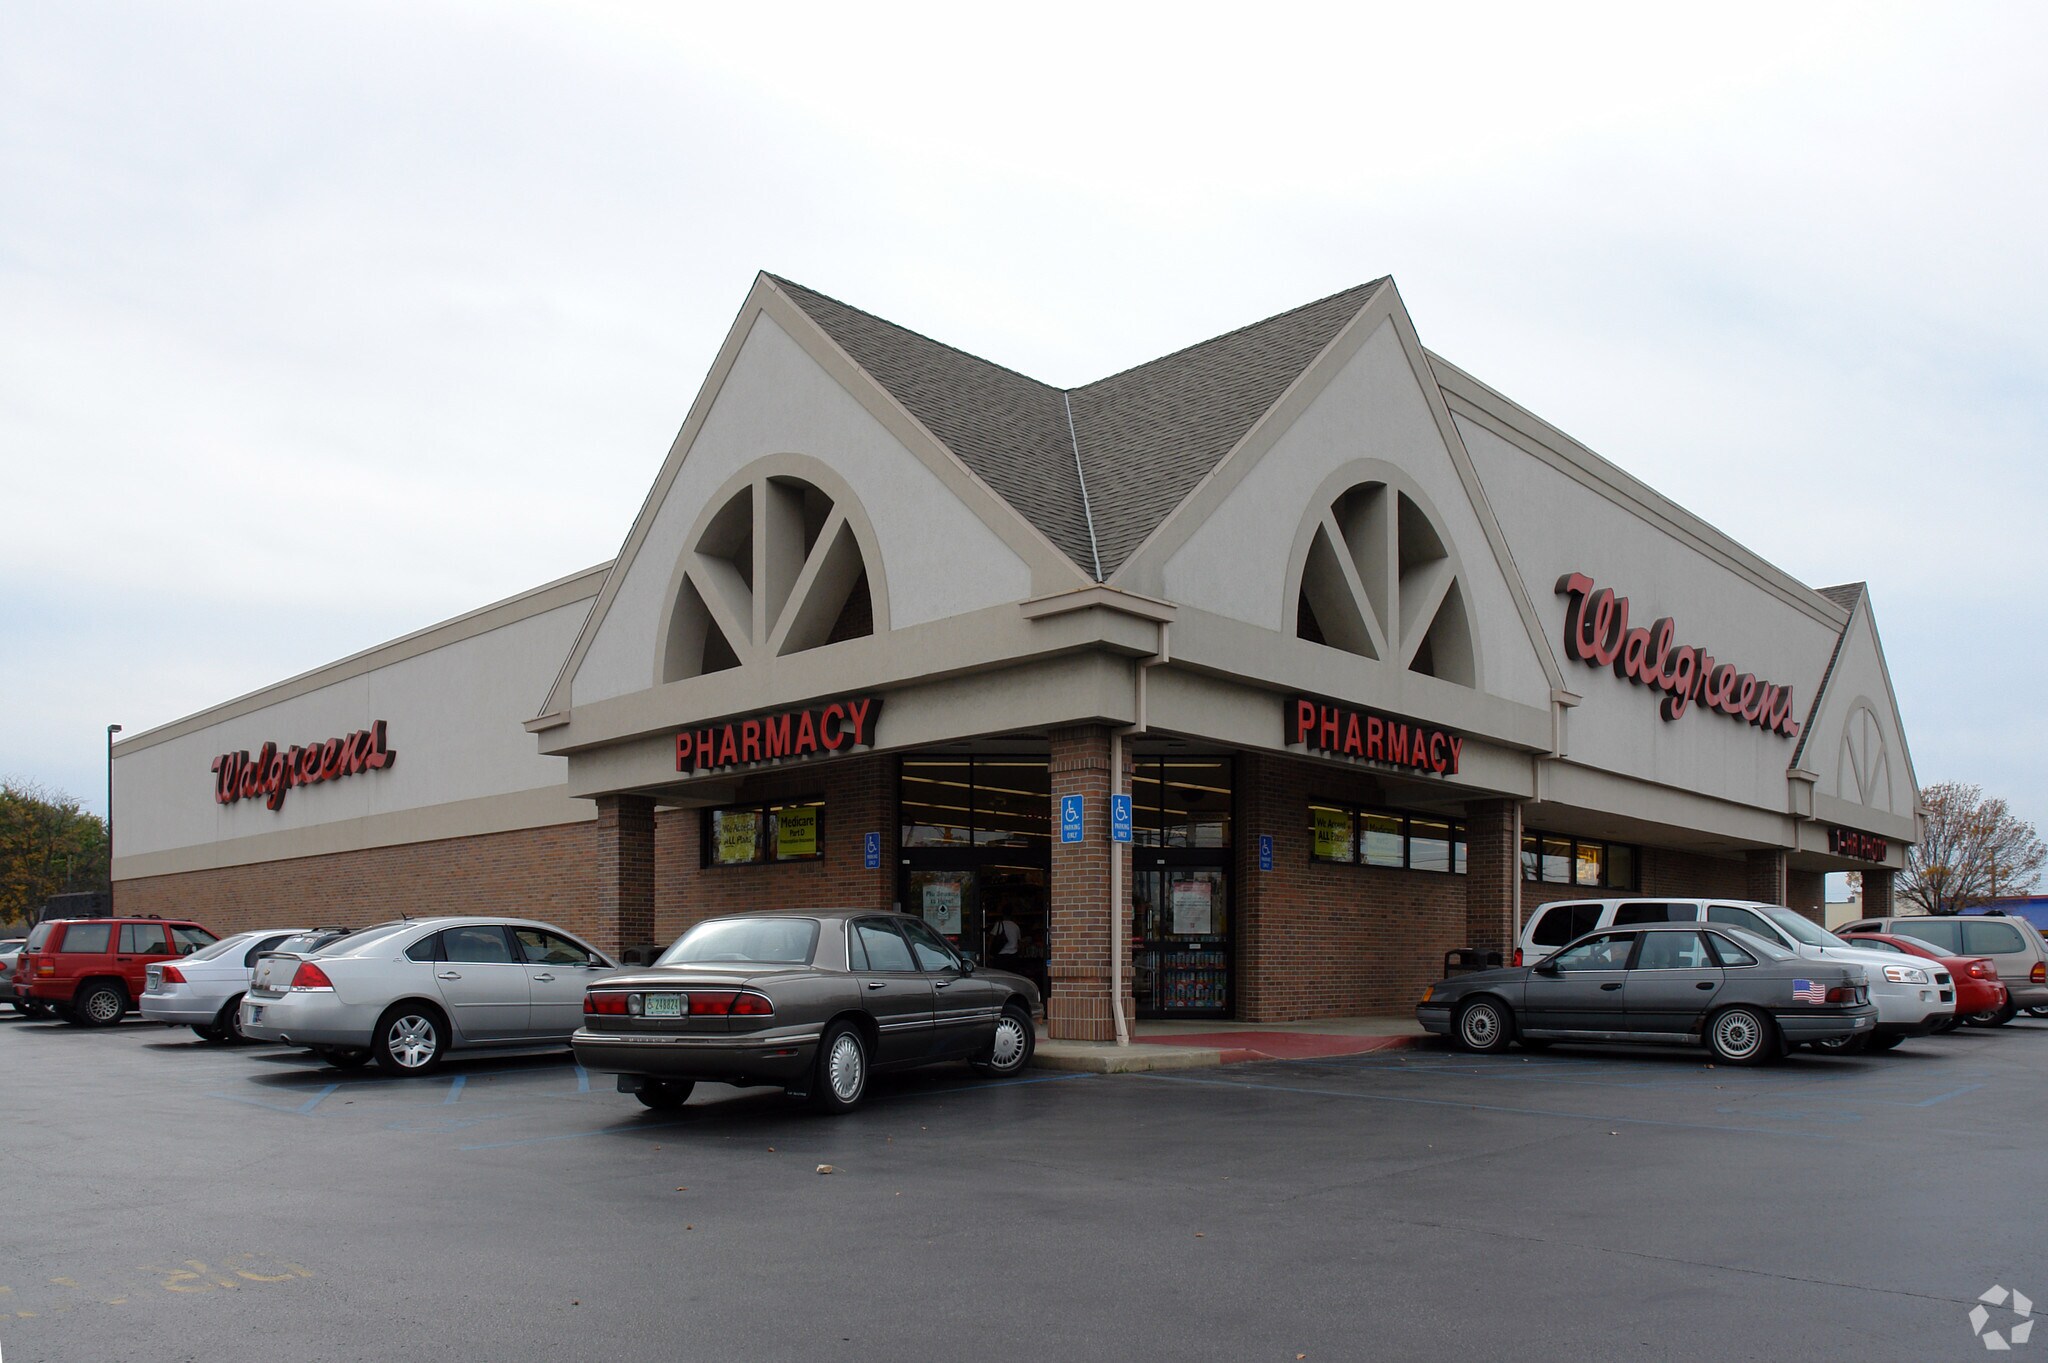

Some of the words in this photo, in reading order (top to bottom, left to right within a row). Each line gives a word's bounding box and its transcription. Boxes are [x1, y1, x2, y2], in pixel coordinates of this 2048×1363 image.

[1555, 572, 1799, 722] Walgreens
[211, 719, 396, 810] Walgreens
[676, 698, 876, 772] PHARMACY
[1296, 699, 1463, 775] PHARMACY
[781, 815, 814, 829] Medicare
[1318, 830, 1330, 841] ALL
